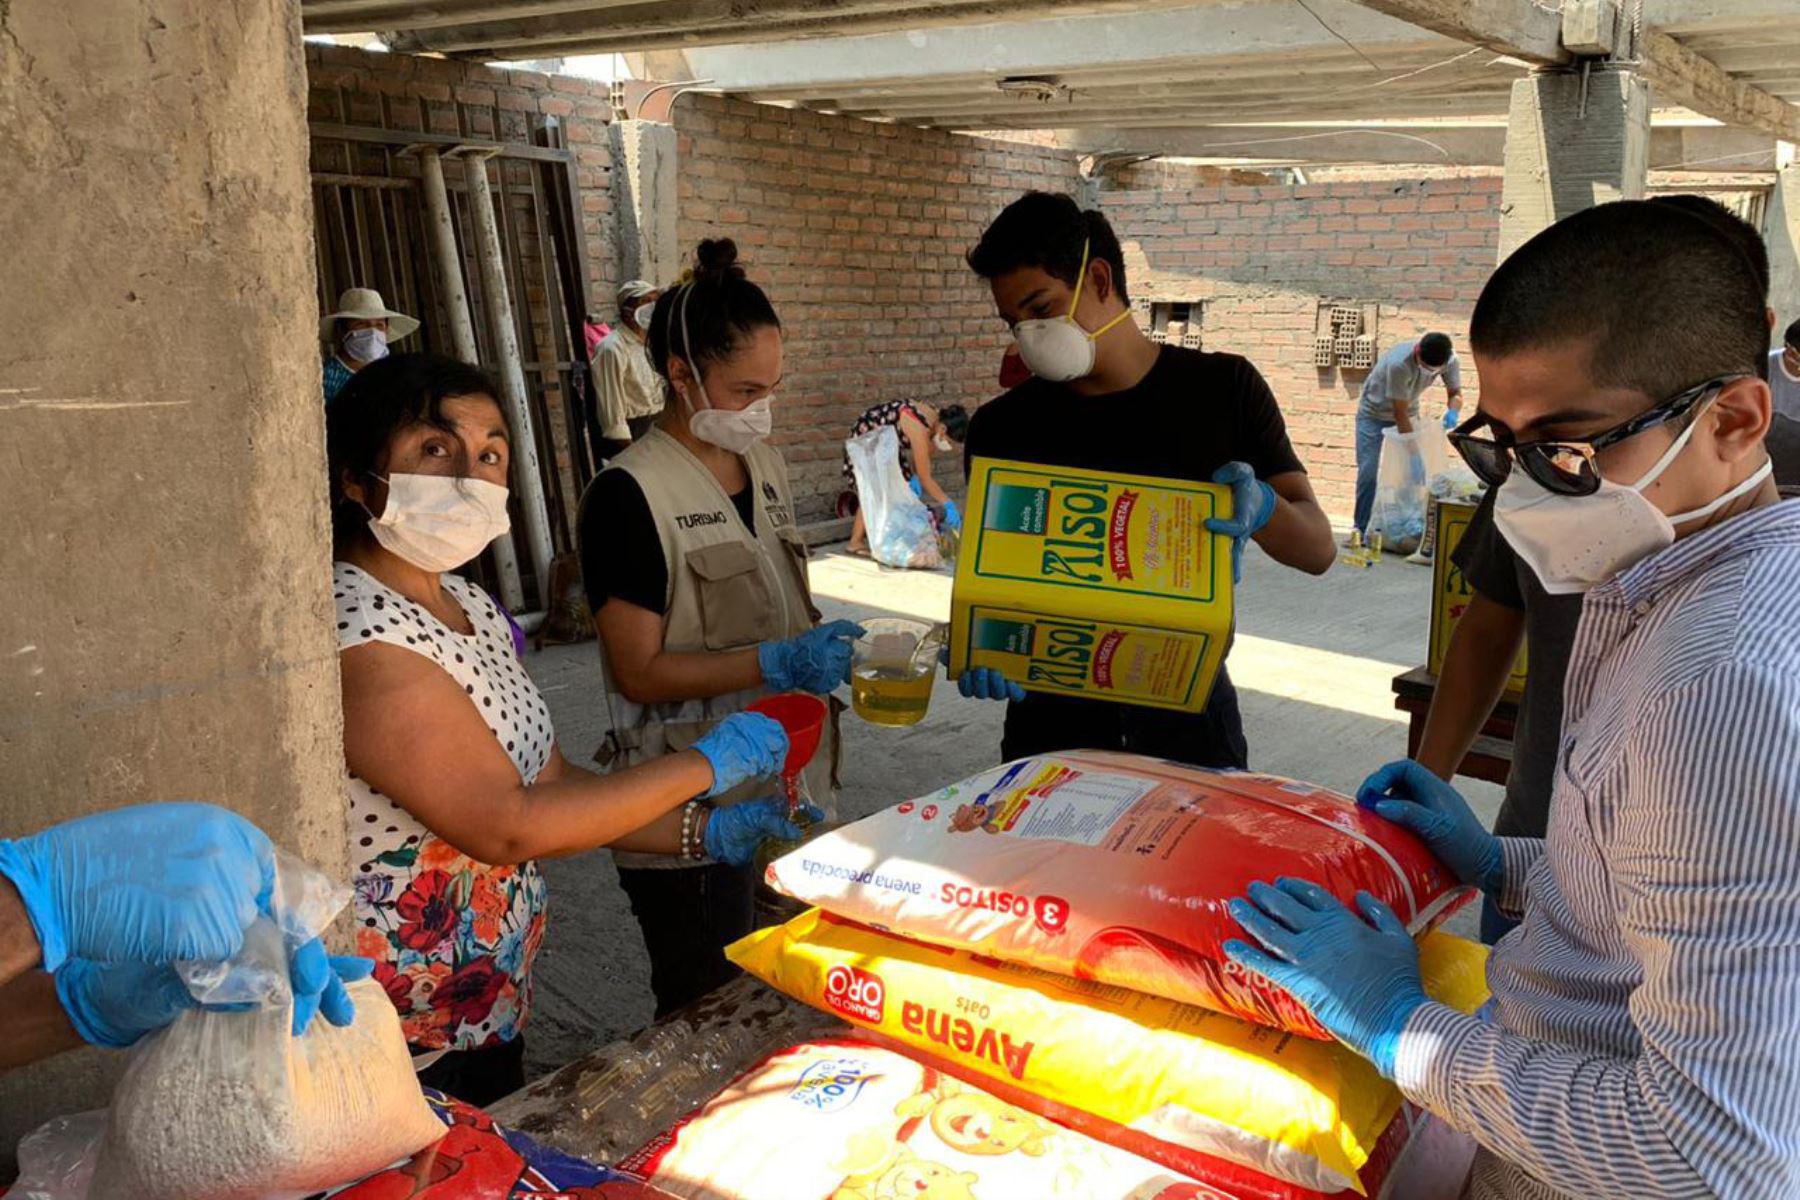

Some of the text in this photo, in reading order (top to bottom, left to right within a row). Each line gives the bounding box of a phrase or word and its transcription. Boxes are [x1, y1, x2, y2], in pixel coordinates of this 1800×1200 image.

[675, 511, 727, 530] TURISMO
[1019, 505, 1031, 533] Aceite
[1032, 488, 1046, 533] comestible
[1113, 499, 1132, 569] 100% VEGETAL
[800, 858, 1060, 926] 3 OSITOS avena precocida
[828, 962, 882, 1007] ORO
[843, 999, 881, 1021] GRANO
[956, 996, 991, 1020] Oats
[902, 1000, 1035, 1081] Avena
[803, 1069, 861, 1109] 100%
